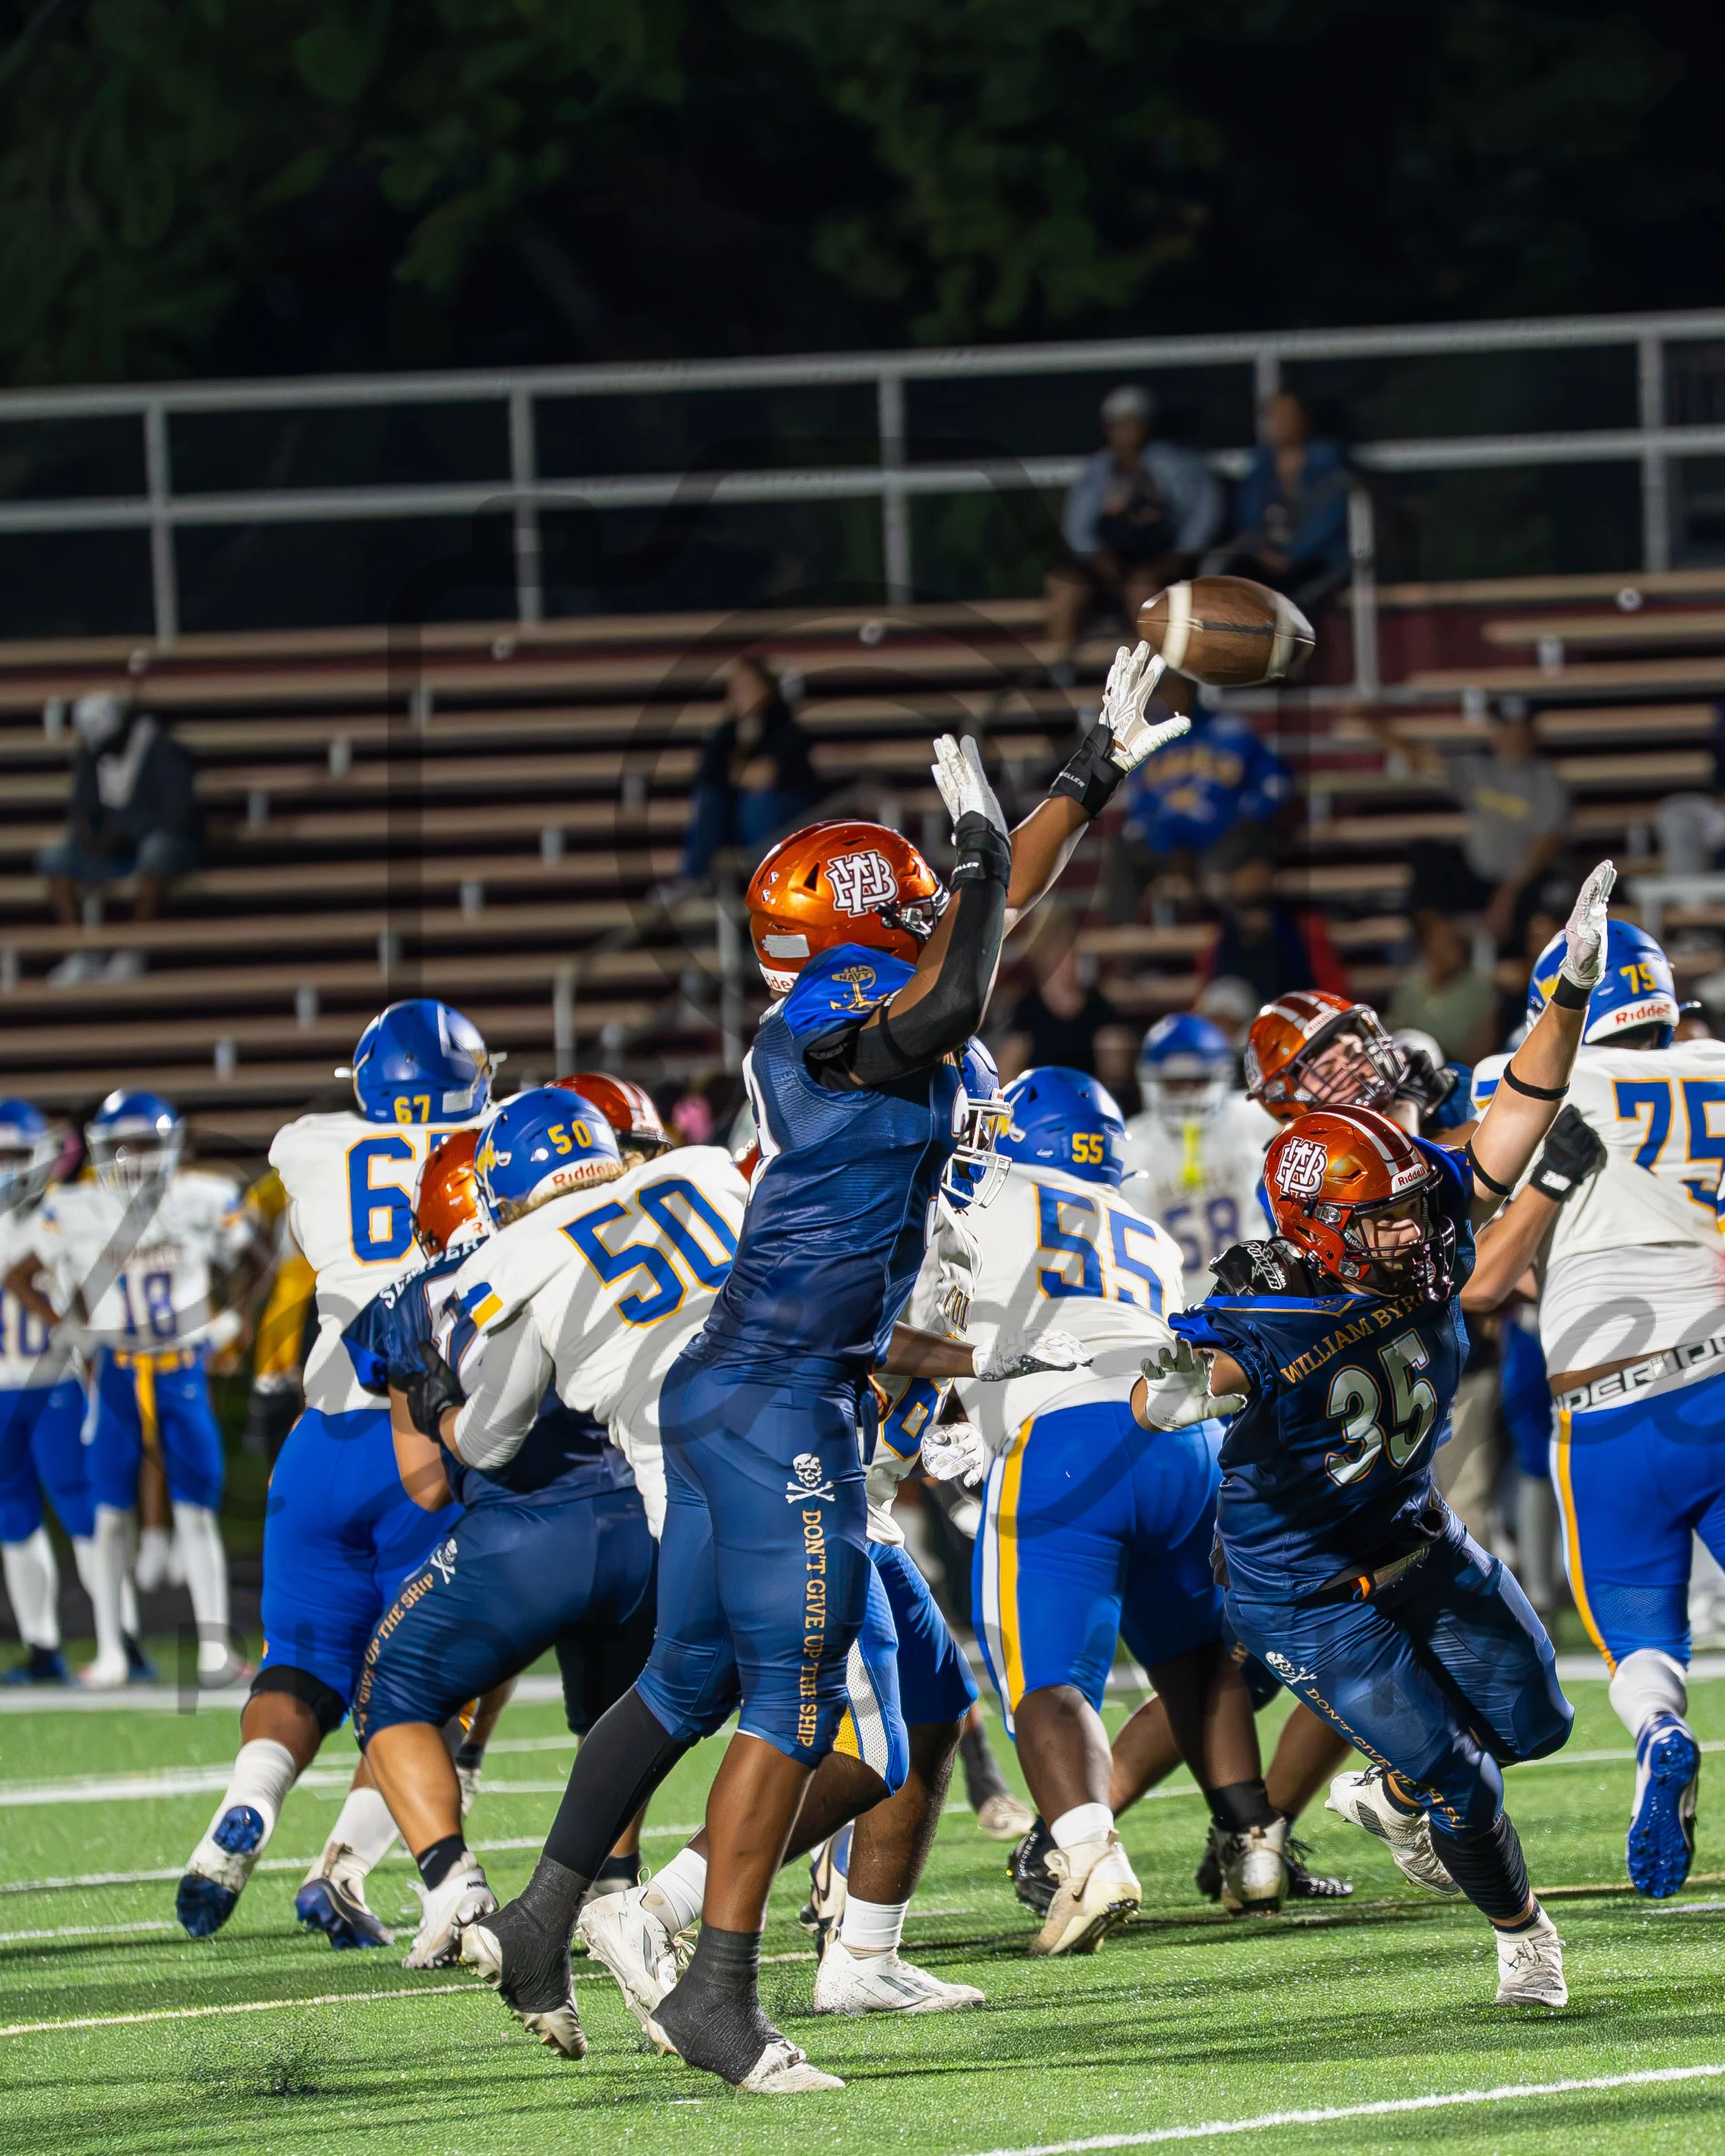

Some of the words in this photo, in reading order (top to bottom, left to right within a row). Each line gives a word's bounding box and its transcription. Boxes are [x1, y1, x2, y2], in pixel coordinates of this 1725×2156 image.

[838, 971, 873, 982] NAVY
[1619, 962, 1657, 995] 75
[393, 1096, 431, 1125] 67
[547, 1120, 593, 1155] 50
[1071, 1132, 1105, 1165] 55
[1610, 1076, 1725, 1218] 75
[1397, 1165, 1426, 1187] Riddell
[560, 1176, 742, 1328] 50
[1033, 1180, 1167, 1318] 55
[116, 1271, 178, 1339] 18
[1279, 1316, 1374, 1384] WILLIAM
[1325, 1327, 1438, 1487] 35
[802, 1510, 827, 1575] DON'T
[364, 1637, 382, 1665] UP
[377, 1603, 406, 1640] THE
[400, 1572, 435, 1610] SHIP
[804, 1579, 827, 1629] GIVE
[802, 1633, 825, 1658] UP
[796, 1703, 818, 1747] SHIP
[1303, 1688, 1355, 1734] DON'T
